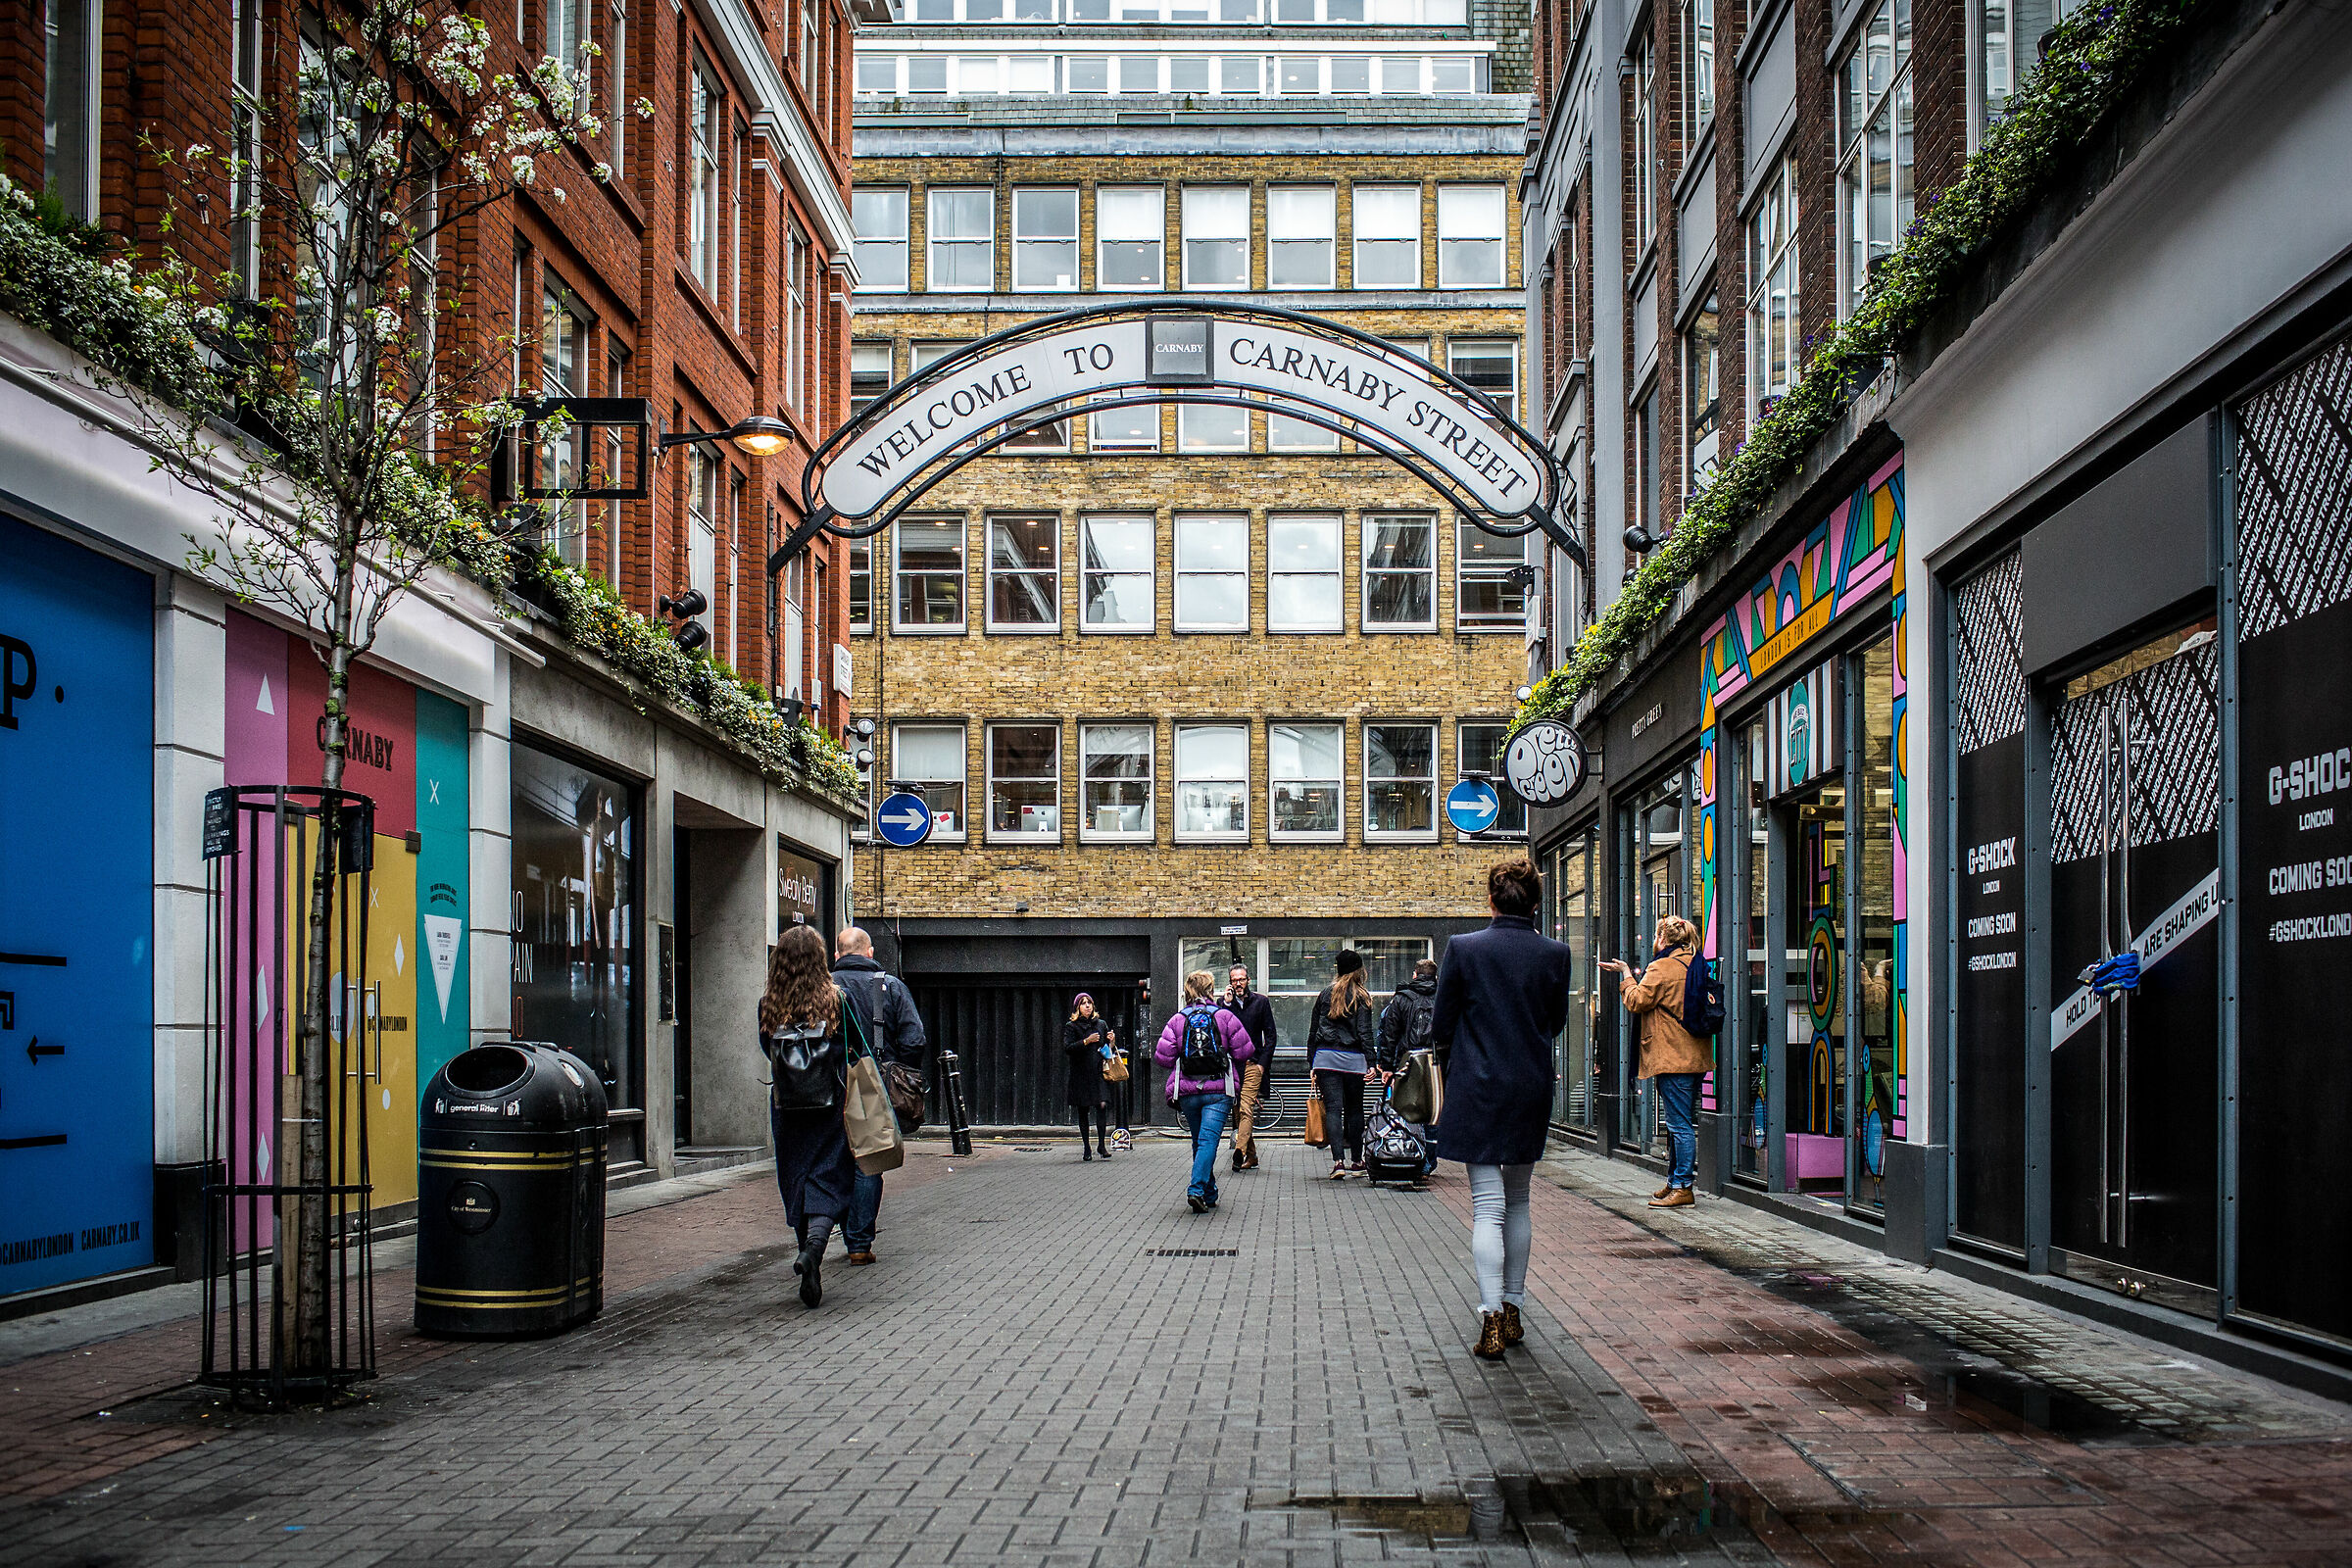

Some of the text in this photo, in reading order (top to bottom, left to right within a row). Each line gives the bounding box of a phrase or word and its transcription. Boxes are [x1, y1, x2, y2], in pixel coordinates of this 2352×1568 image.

[1154, 342, 1204, 354] CARNABY
[856, 343, 1114, 478] WELCOME TO
[1229, 337, 1528, 499] CARNABY STREET
[2313, 458, 2352, 574] CONSTRUCTIO
[1760, 610, 1818, 669] LONDON IS FOR ALL
[1632, 703, 1662, 739] PRETTY GREEN
[317, 715, 394, 772] CRNABY
[2269, 747, 2352, 806] G-SHOC
[2299, 808, 2333, 831] LONDON
[1968, 836, 2017, 875] G-SHOCK
[778, 867, 802, 909] Sweaty
[802, 875, 817, 913] Betty
[1983, 880, 2000, 895] LONDON
[2269, 856, 2352, 896] COMING SOO
[1968, 911, 2017, 938] COMING SOON
[2142, 927, 2162, 961] ARE
[2164, 891, 2209, 943] SHAPING
[2269, 912, 2352, 943] #GSHOCKLOND
[1968, 952, 2017, 971] #GSHOCKLONDON
[2066, 995, 2086, 1028] HOLD
[450, 1103, 500, 1113] general litter
[81, 1220, 140, 1251] CARNABY.CO.UK
